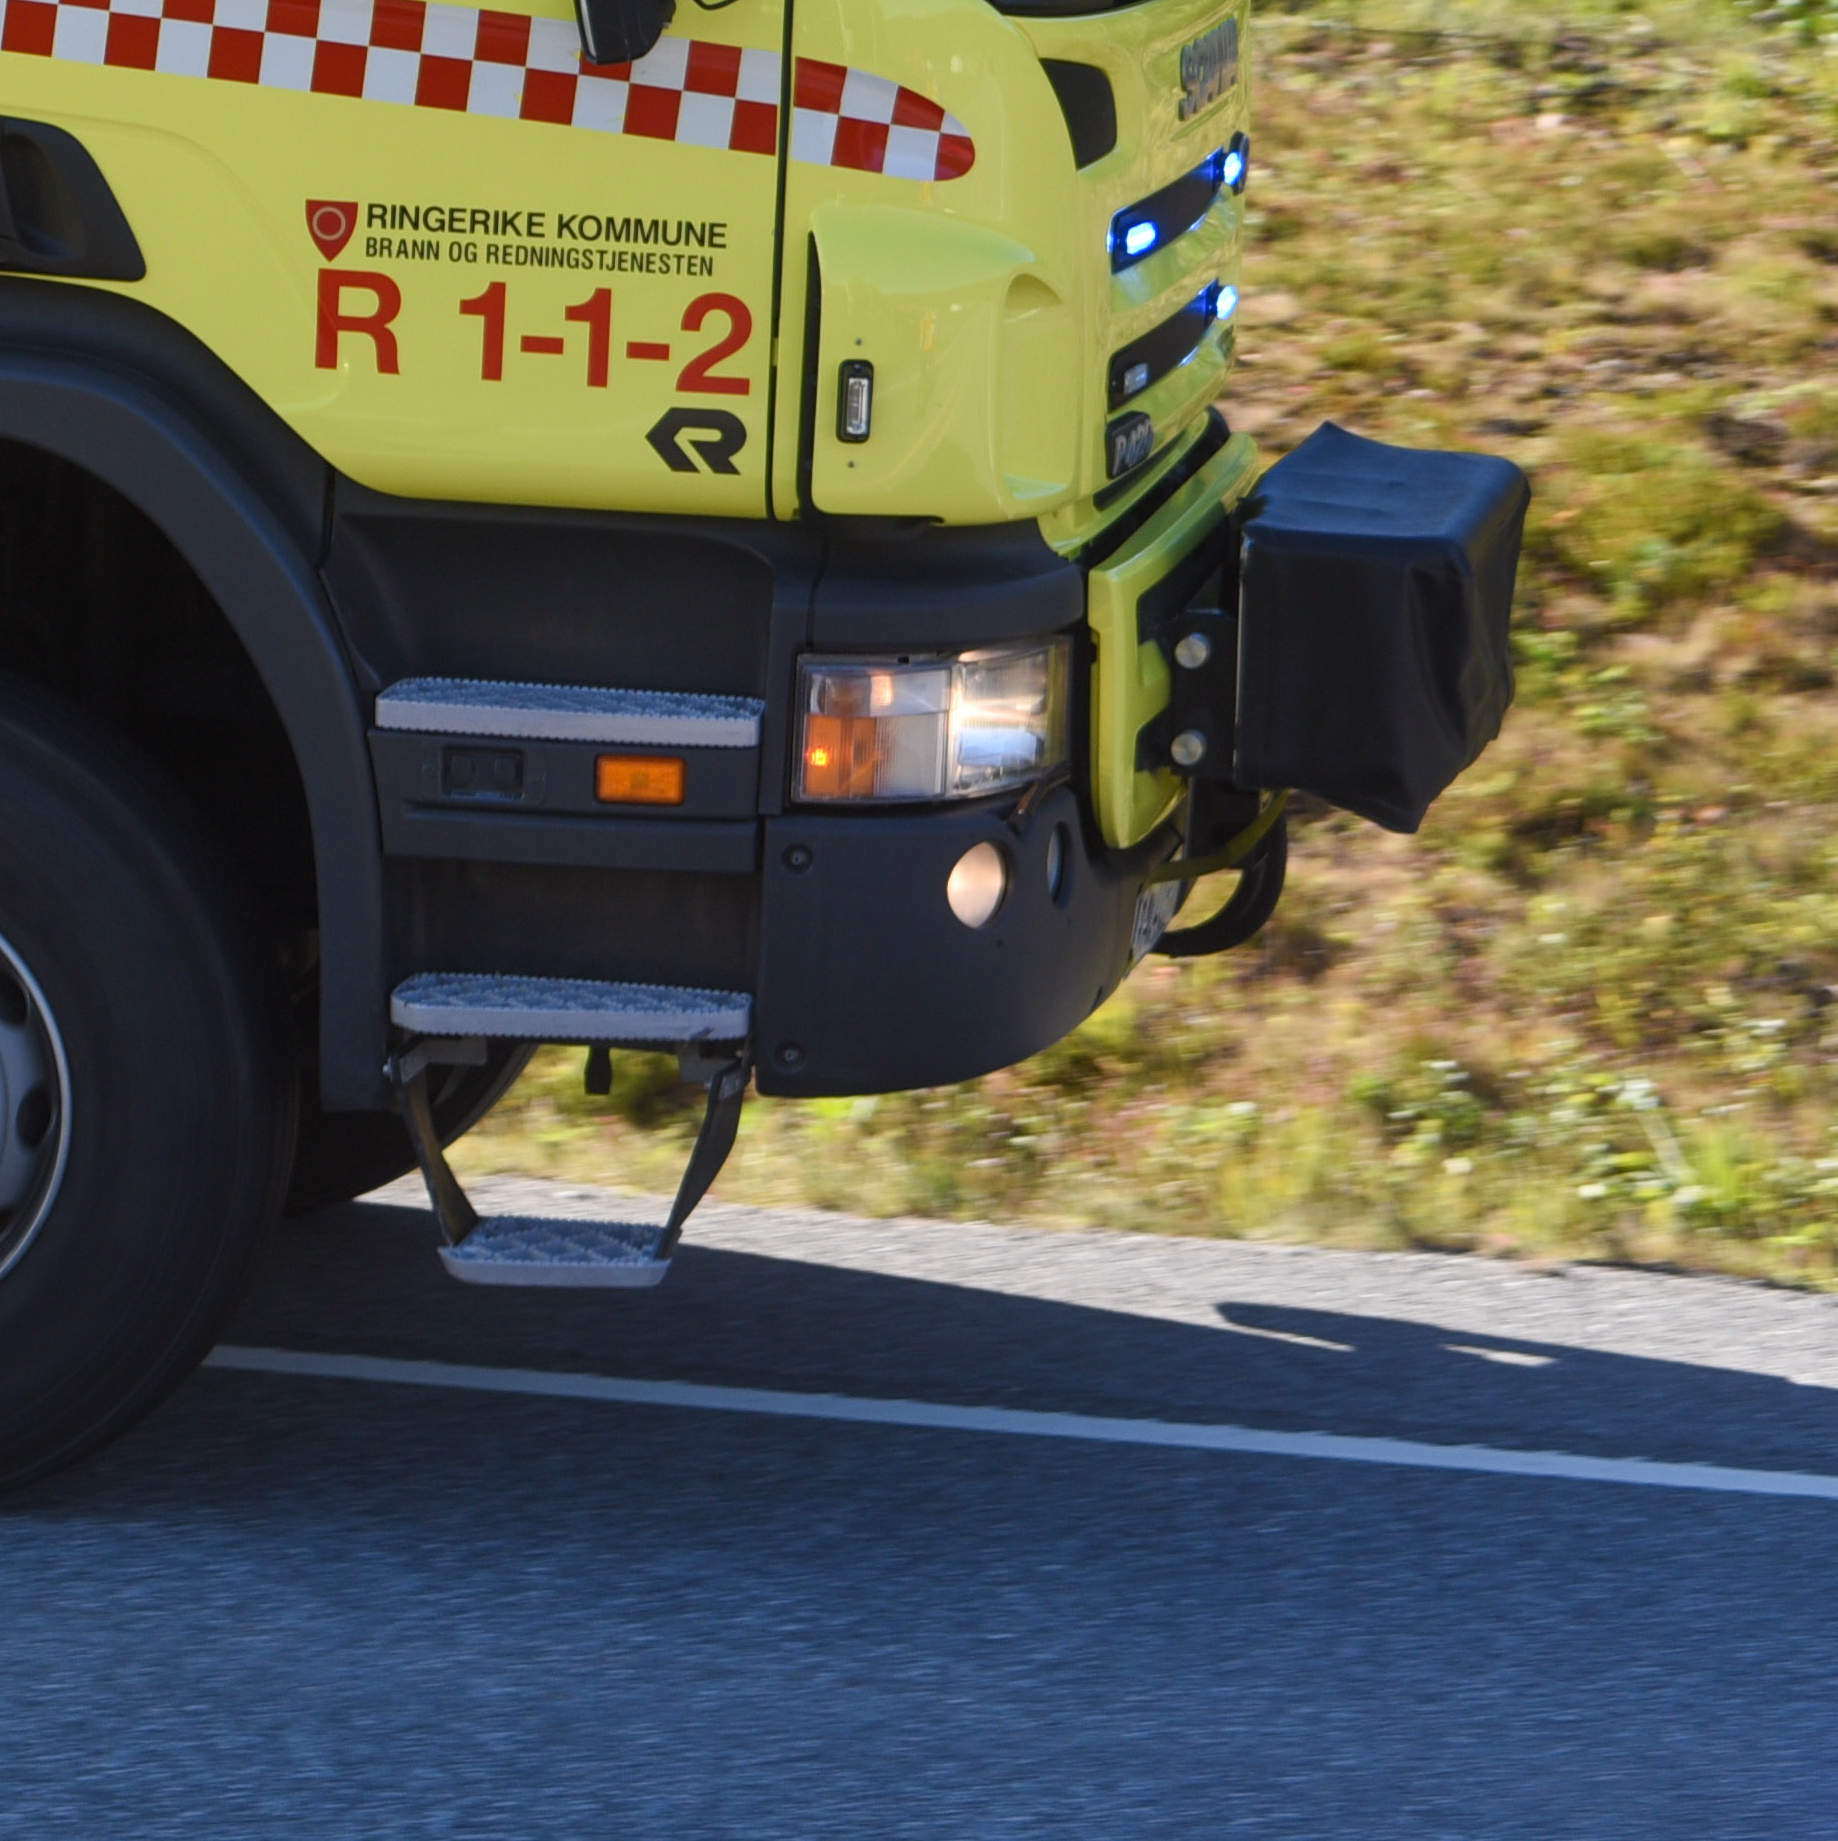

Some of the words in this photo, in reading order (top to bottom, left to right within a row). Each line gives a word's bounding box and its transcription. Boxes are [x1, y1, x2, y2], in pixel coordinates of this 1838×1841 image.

[366, 203, 546, 239] RINGERIKE
[556, 213, 729, 249] KOMMUNE
[365, 236, 440, 261] BRANN
[448, 241, 478, 264] OG
[486, 243, 714, 277] REDNINGSTJENESTEN
[315, 268, 402, 375] R
[459, 281, 753, 396] 1-1-2
